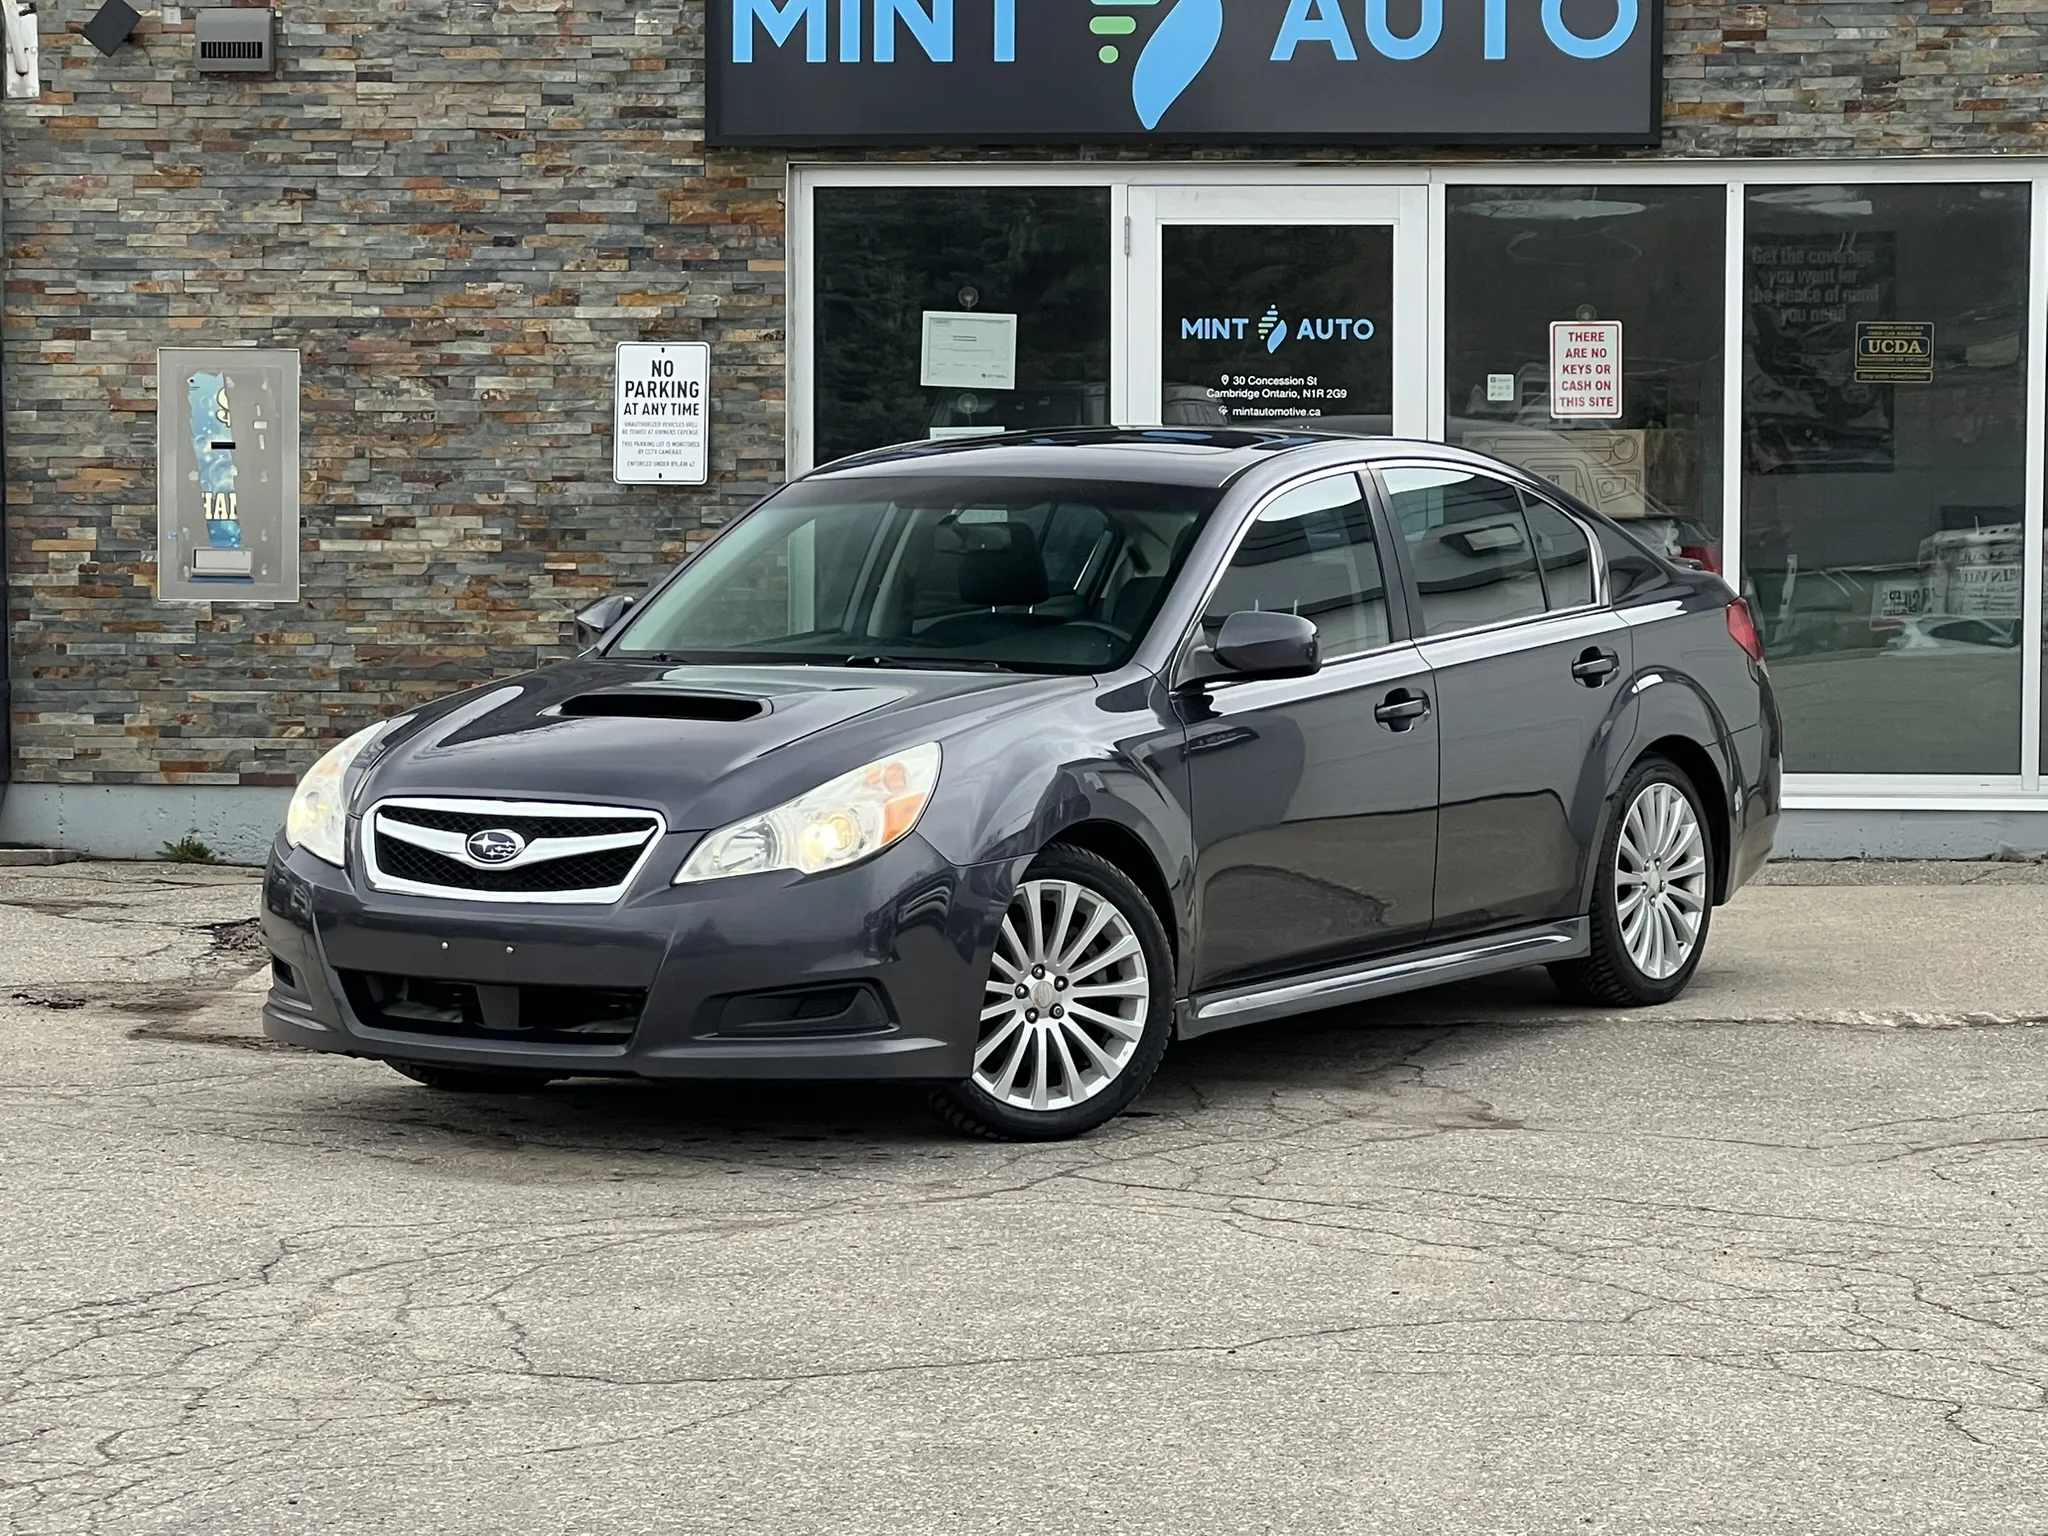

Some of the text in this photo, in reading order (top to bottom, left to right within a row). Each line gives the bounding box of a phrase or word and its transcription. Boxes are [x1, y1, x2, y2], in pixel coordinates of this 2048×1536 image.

[1752, 246, 1778, 265] Get
[1781, 246, 1804, 265] the
[1767, 269, 1794, 288] you
[1781, 307, 1806, 326] you
[1181, 318, 1375, 340] MINT AUTO
[1568, 332, 1605, 342] THERE
[1565, 348, 1607, 358] ARE NO
[1868, 340, 1922, 354] UCDA
[652, 360, 674, 377] NO
[1562, 364, 1611, 375] KEYS OR
[1233, 376, 1318, 386] 30 Concession St
[1561, 380, 1611, 391] CASH ON
[625, 380, 699, 398] PARKING
[1206, 388, 1347, 400] Cambridge Ontario, N1R 2G9
[1560, 396, 1613, 407] THIS SITE
[623, 402, 699, 416] AT ANY TIME
[1232, 405, 1322, 417] mintautomotive.ca
